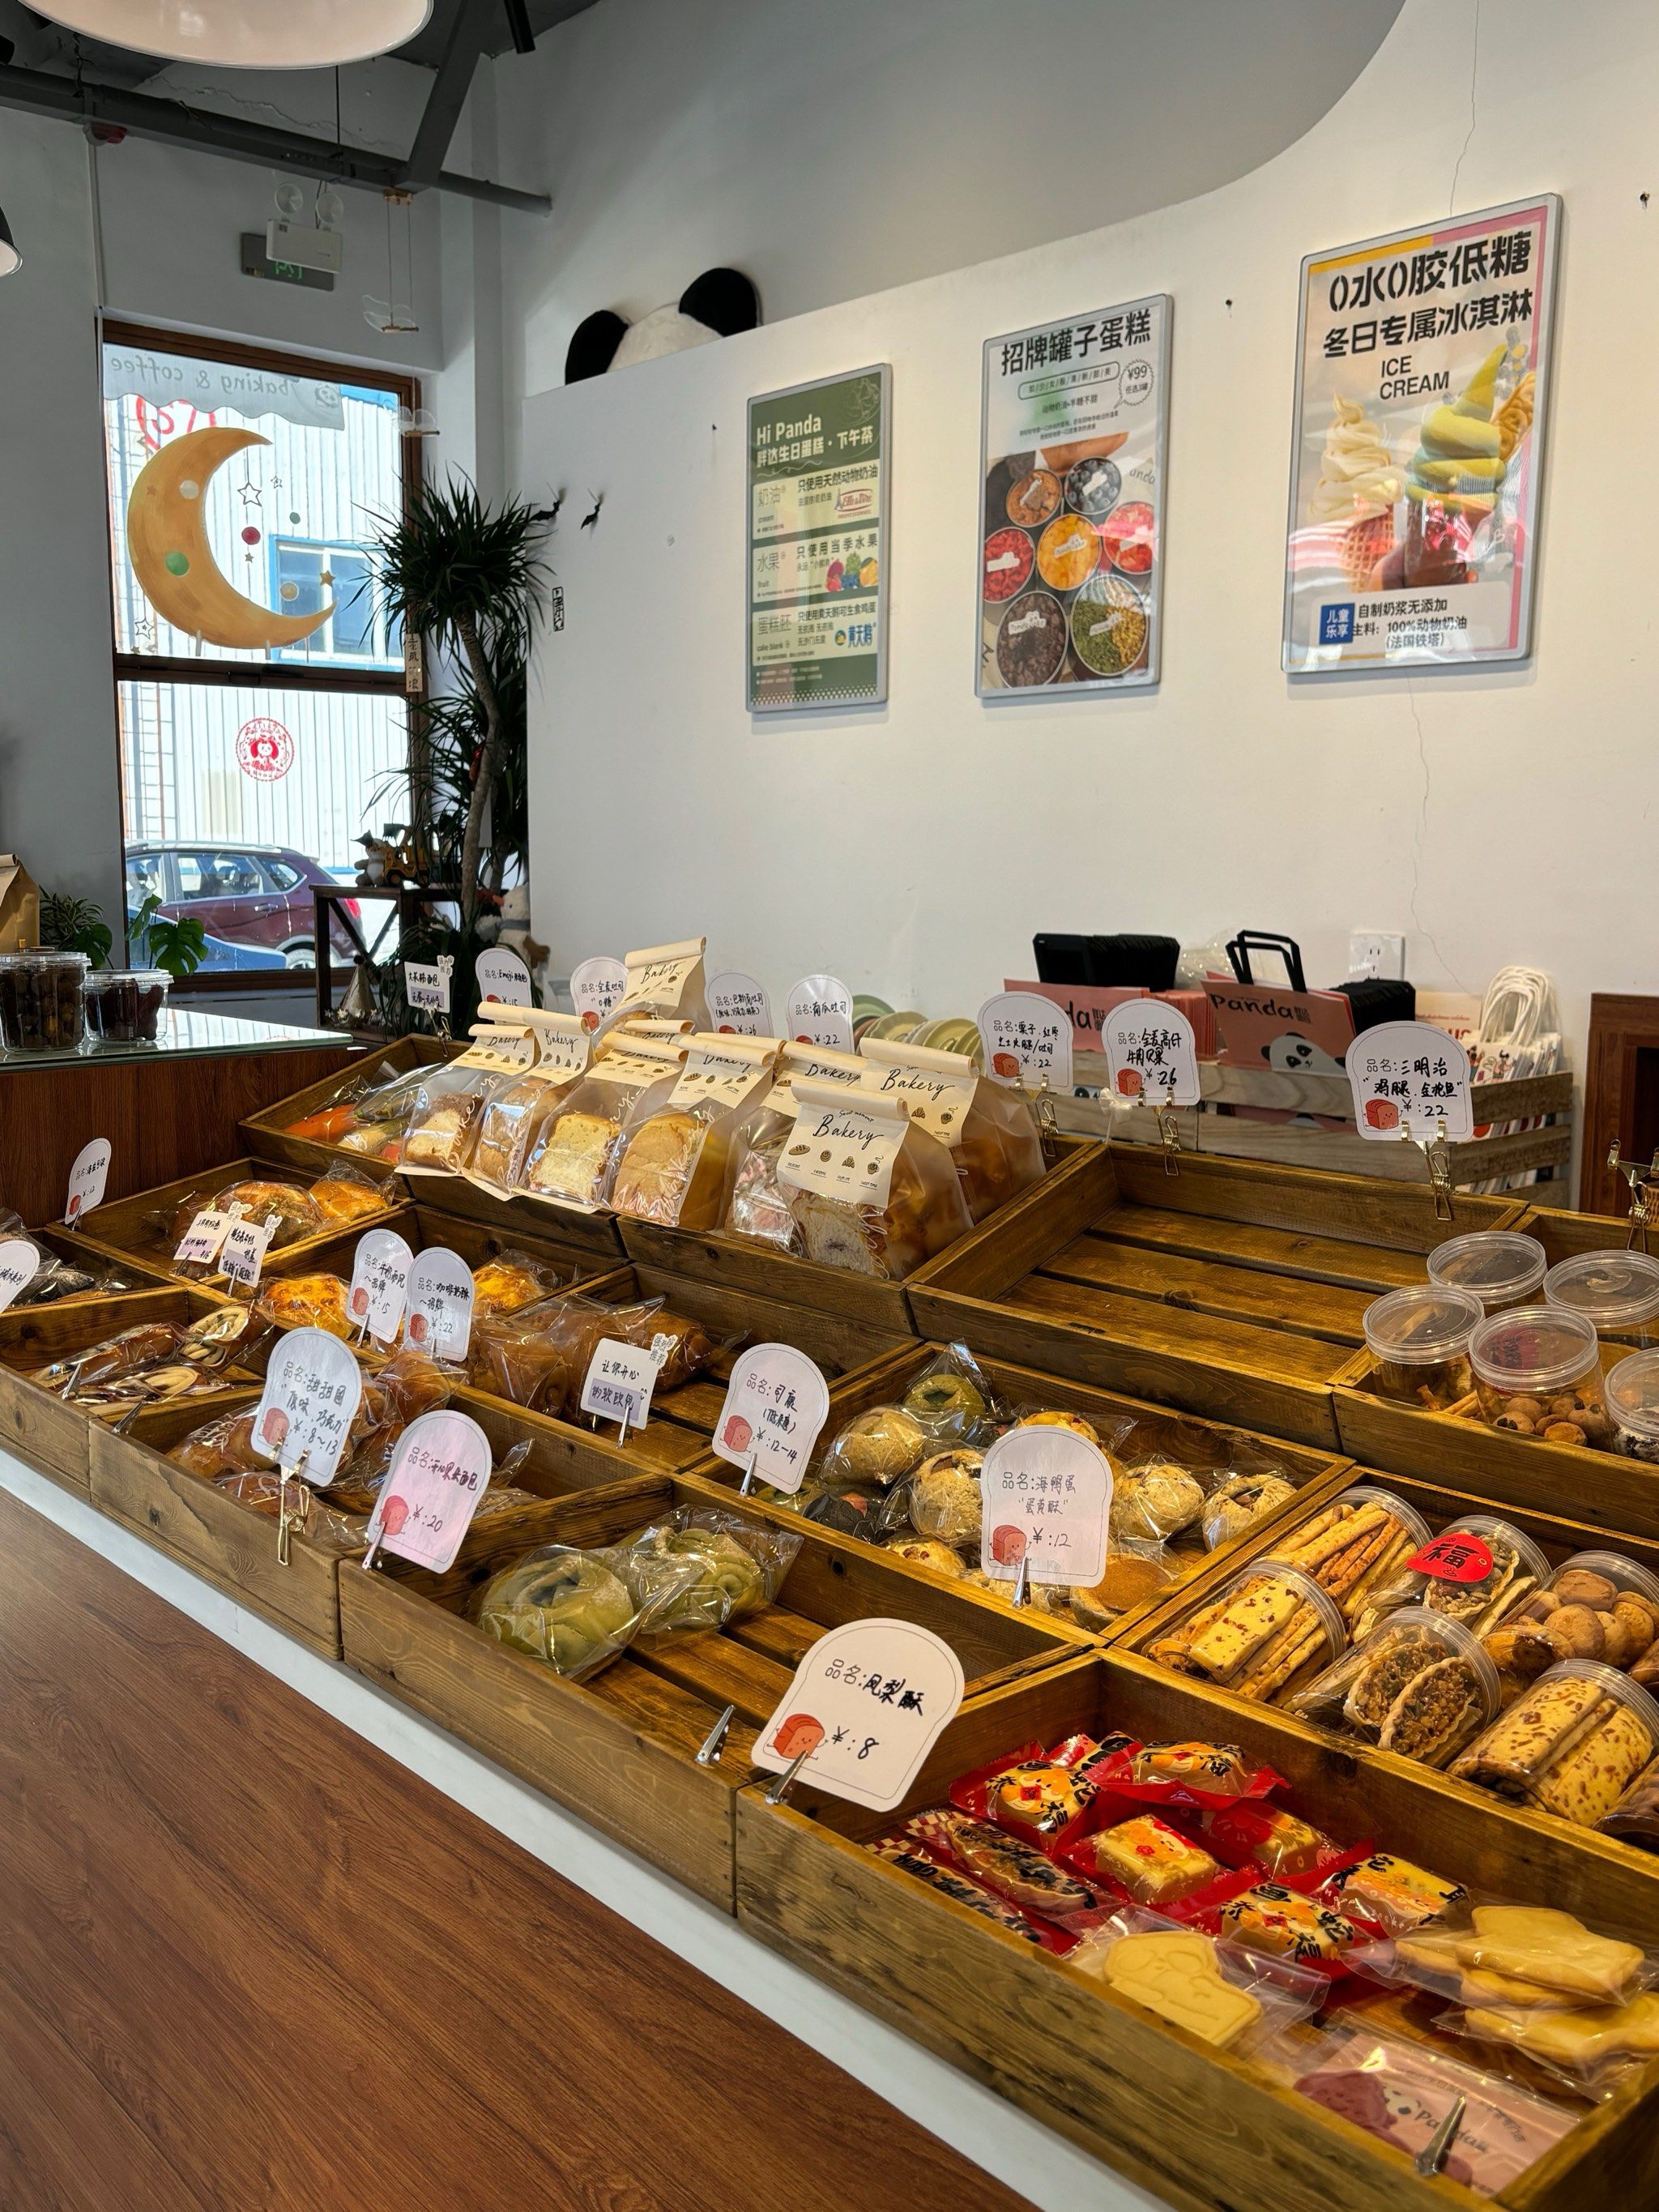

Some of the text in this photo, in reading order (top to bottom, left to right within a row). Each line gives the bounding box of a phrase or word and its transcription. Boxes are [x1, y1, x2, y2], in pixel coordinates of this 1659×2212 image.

[1323, 288, 1533, 358] 冬日专属冰淇淋
[1001, 308, 1151, 377] 招牌罐子蛋糕
[1128, 365, 1149, 381] ¥99
[1380, 355, 1413, 378] ICE
[1380, 371, 1450, 400] CREAM
[757, 413, 821, 446] Hi Panda
[1325, 609, 1350, 624] 儿童
[1358, 598, 1448, 618] 自制奶浆无添加
[544, 1028, 579, 1054] Bakery
[1366, 1057, 1448, 1078] 品名:三明治
[880, 1068, 956, 1102] Bakery
[812, 1114, 885, 1151] Bakery
[602, 1360, 640, 1380] 让你开心
[747, 1373, 798, 1412] 品名:司康
[1002, 1471, 1077, 1495] 品名:海鸭蛋
[1422, 1541, 1478, 1569] 福
